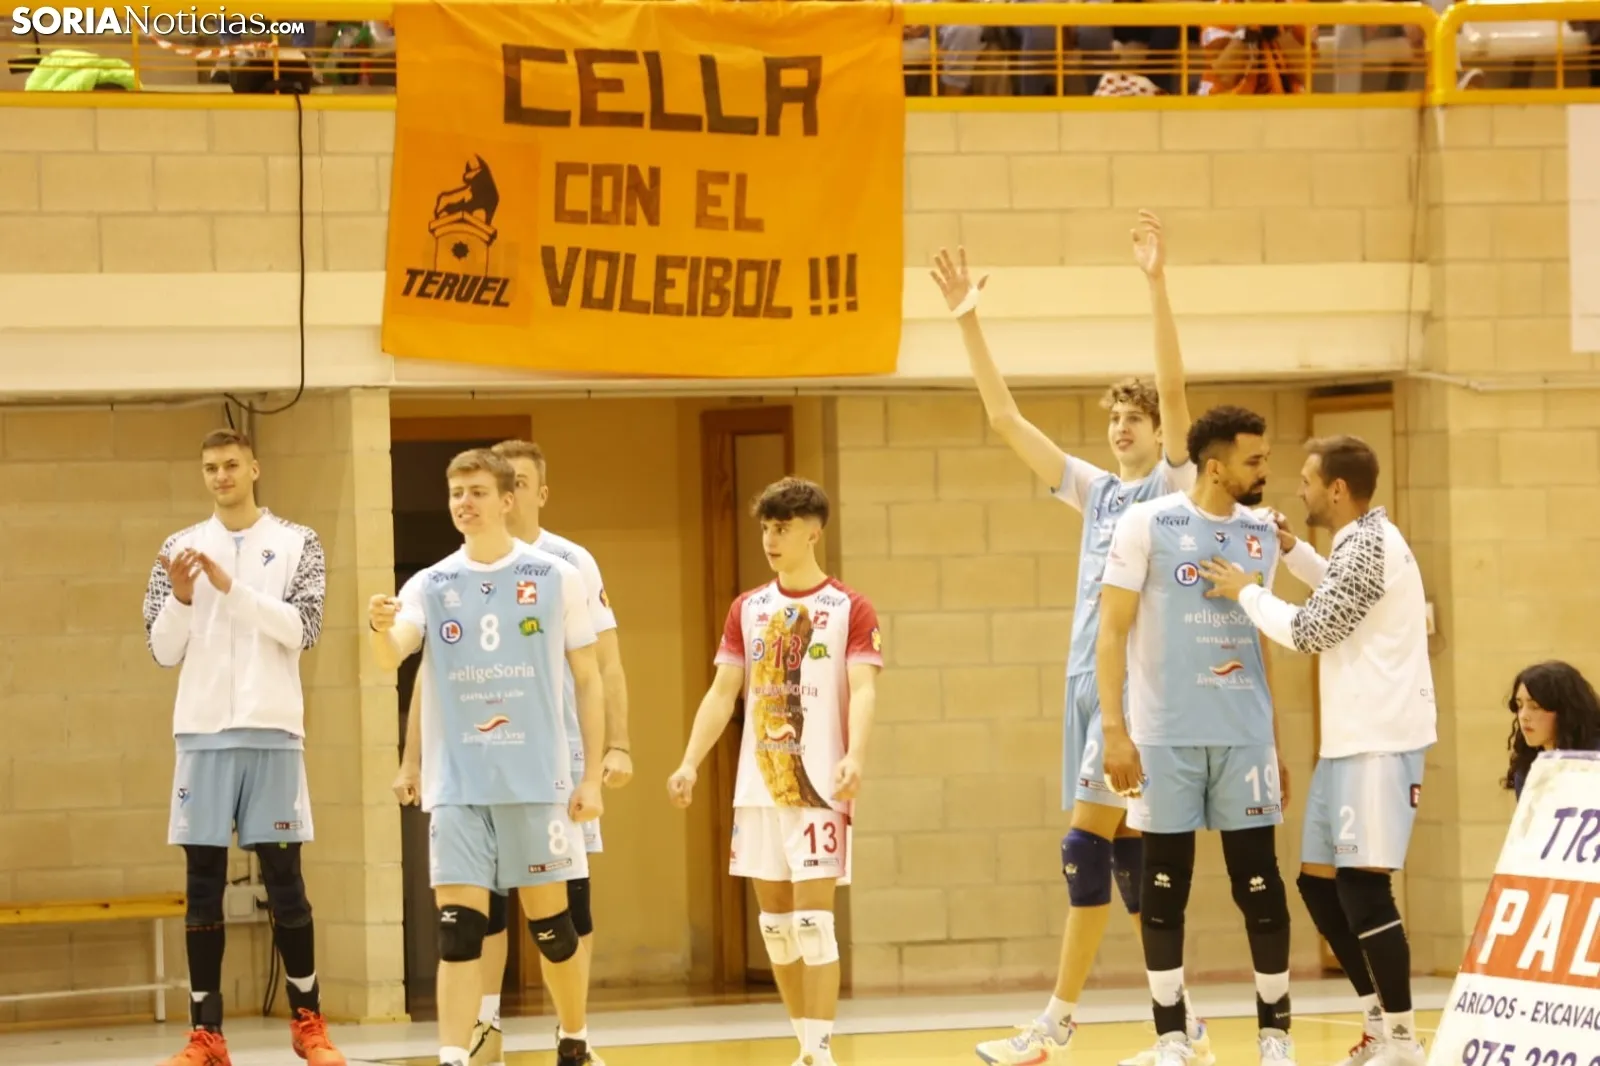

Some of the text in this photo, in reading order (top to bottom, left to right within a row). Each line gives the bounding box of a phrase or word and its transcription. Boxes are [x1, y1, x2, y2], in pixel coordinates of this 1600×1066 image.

[502, 43, 822, 136] CELLA
[554, 161, 765, 233] CON EL
[401, 268, 510, 308] TERUEL
[541, 246, 793, 319] VOLEIBOL
[480, 613, 500, 651] 8
[771, 634, 802, 670] 13
[1080, 740, 1098, 775] 2
[1244, 763, 1276, 803] 19
[547, 819, 569, 856] 8
[803, 821, 839, 855] 13
[1340, 804, 1357, 841] 2
